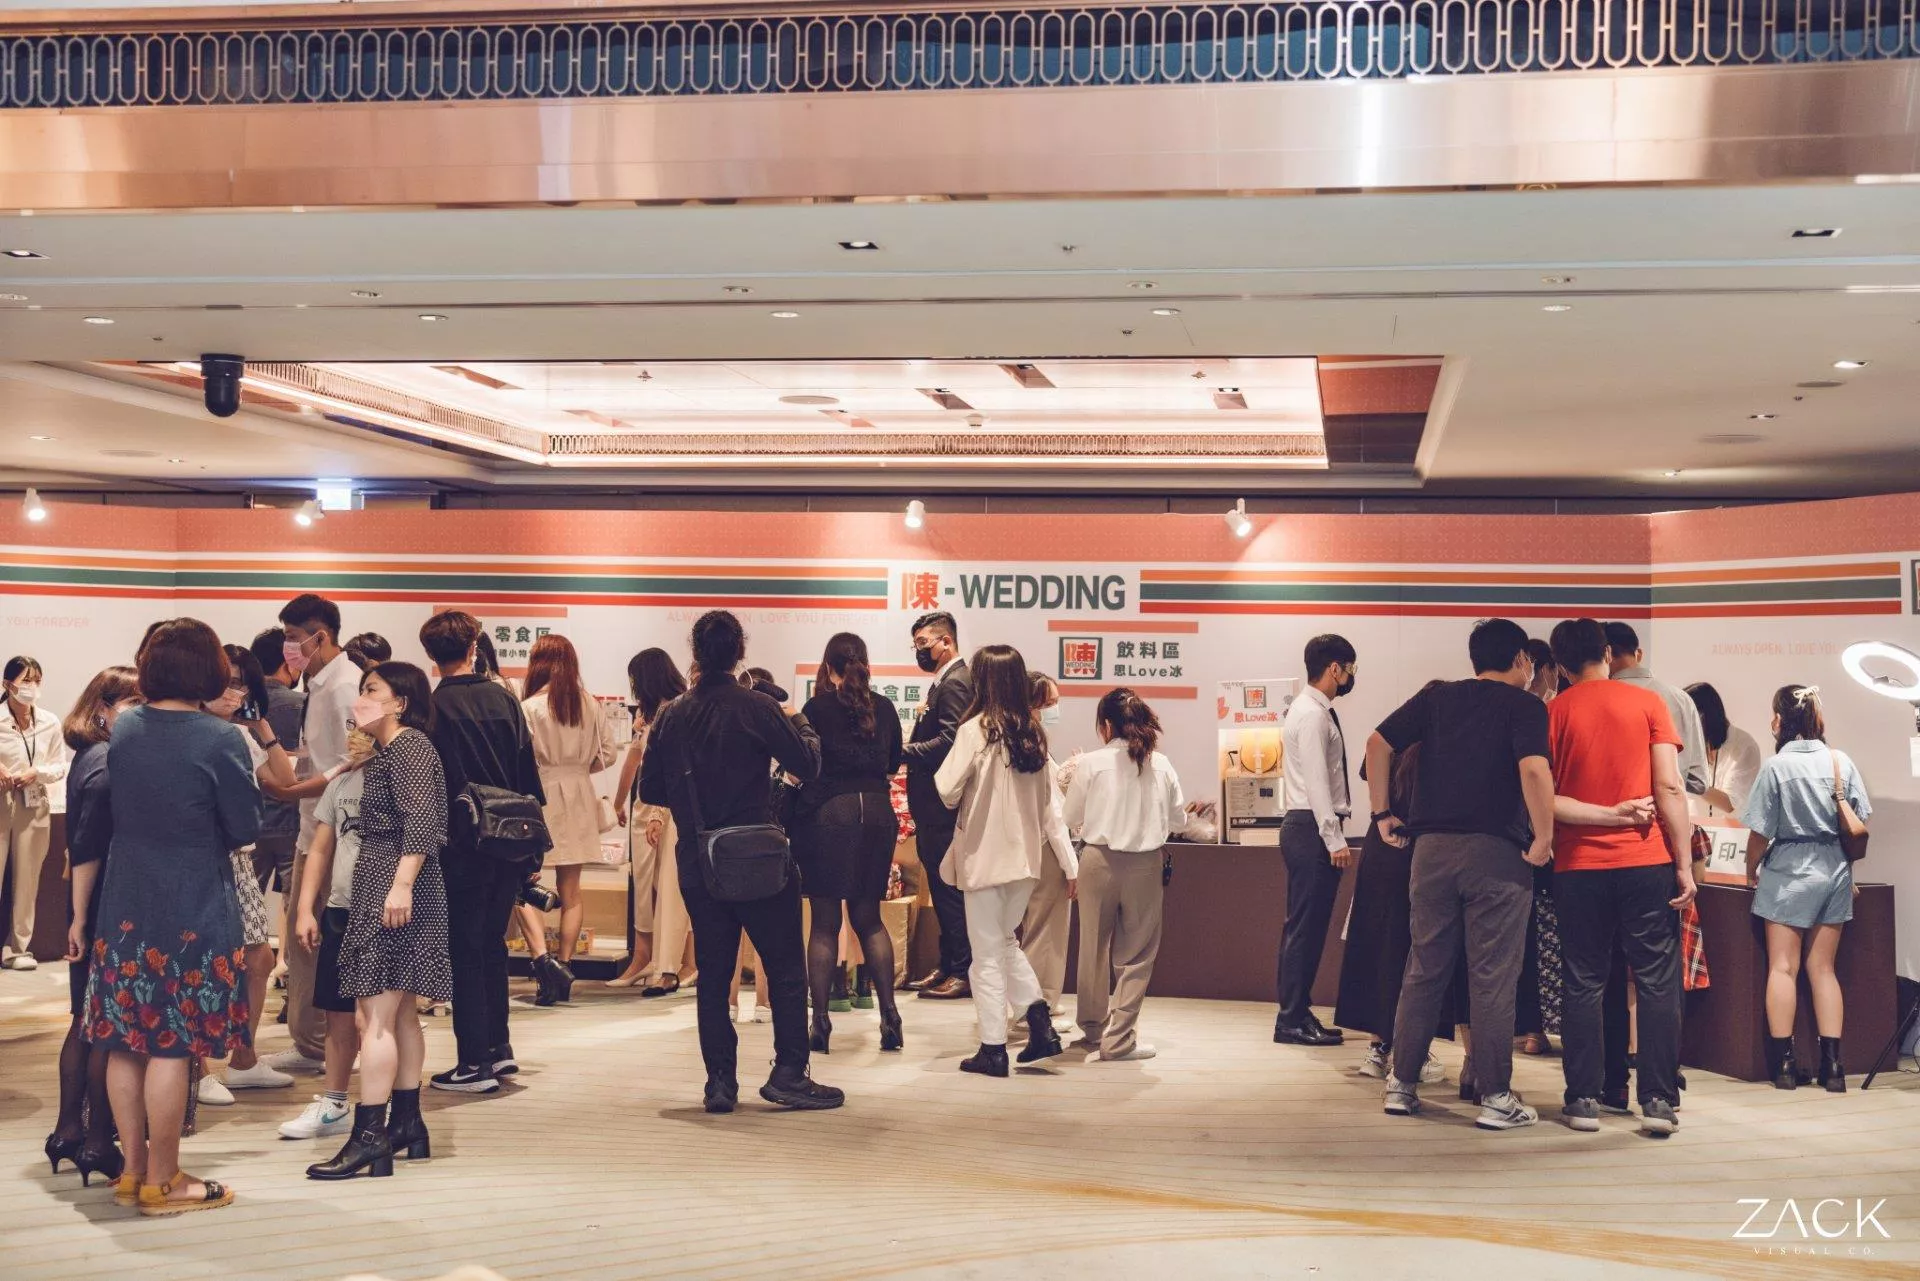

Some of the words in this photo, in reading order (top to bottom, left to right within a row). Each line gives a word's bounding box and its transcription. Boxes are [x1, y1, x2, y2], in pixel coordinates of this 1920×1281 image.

[32, 616, 90, 628] FOREVER
[760, 612, 790, 624] LOVE
[795, 612, 818, 624] YOU
[822, 613, 879, 625] FOREVER
[1116, 641, 1180, 659] 飲料區
[1711, 642, 1751, 656] ALWAYS
[1787, 642, 1815, 656] LOVE
